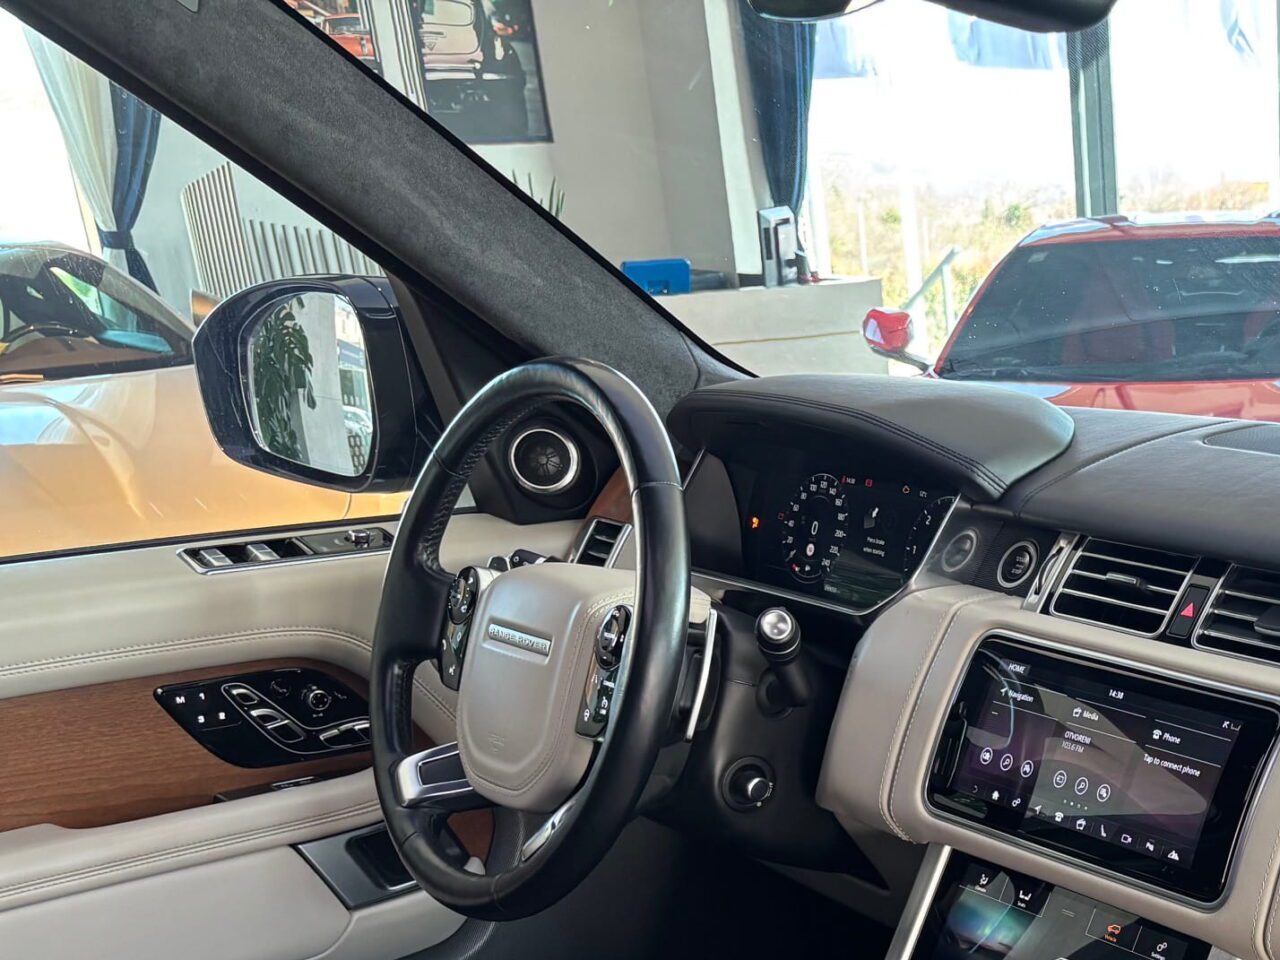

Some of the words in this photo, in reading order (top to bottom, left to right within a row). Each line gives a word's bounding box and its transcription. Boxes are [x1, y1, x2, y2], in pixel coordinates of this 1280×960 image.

[820, 481, 828, 489] 120
[800, 492, 807, 500] 80
[835, 498, 843, 506] 160
[792, 504, 800, 512] 60
[788, 520, 795, 528] 40
[925, 515, 932, 525] 2
[811, 520, 819, 535] 0
[834, 529, 844, 538] 200
[786, 536, 794, 544] 20
[829, 545, 839, 554] 220
[912, 545, 917, 555] 1
[821, 558, 831, 567] 240
[489, 627, 515, 641] RANGE
[516, 635, 548, 651] ROVER
[1008, 663, 1027, 674] HOME
[175, 696, 186, 704] M
[199, 692, 205, 700] 1
[1008, 689, 1034, 703] Navigation
[1108, 689, 1124, 700] 14:38
[197, 715, 205, 723] 3
[1082, 710, 1099, 721] Media
[1064, 730, 1092, 745] OTVORENI
[1162, 732, 1181, 745] Phone
[1075, 744, 1085, 753] FM
[1143, 753, 1152, 764] Tap
[1153, 756, 1160, 765] to
[1160, 760, 1182, 772] connect
[1181, 765, 1201, 778] phone
